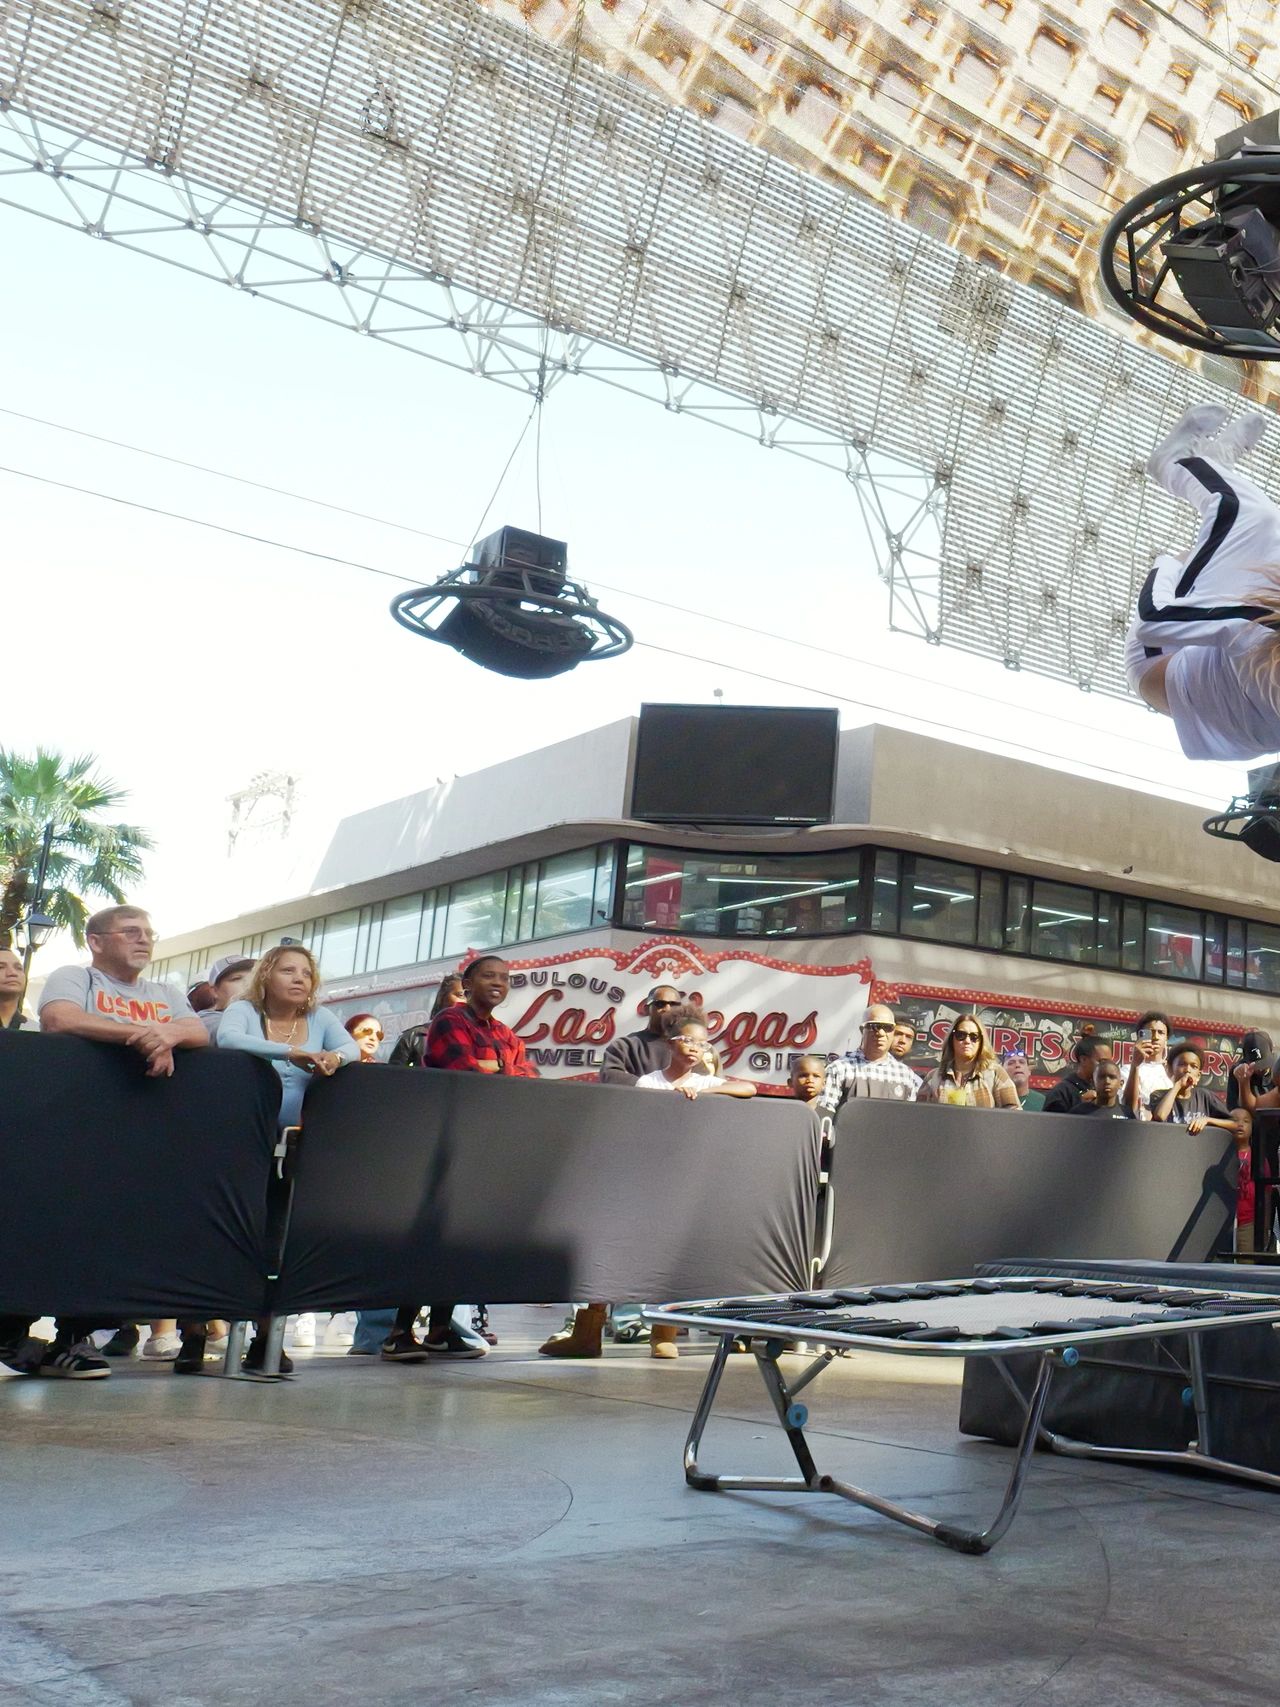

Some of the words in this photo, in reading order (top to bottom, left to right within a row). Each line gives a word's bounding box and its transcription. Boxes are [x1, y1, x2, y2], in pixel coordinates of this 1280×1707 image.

[508, 970, 627, 1004] BULOUS
[96, 989, 172, 1025] USMC
[511, 988, 617, 1047] Las
[637, 991, 819, 1069] egas
